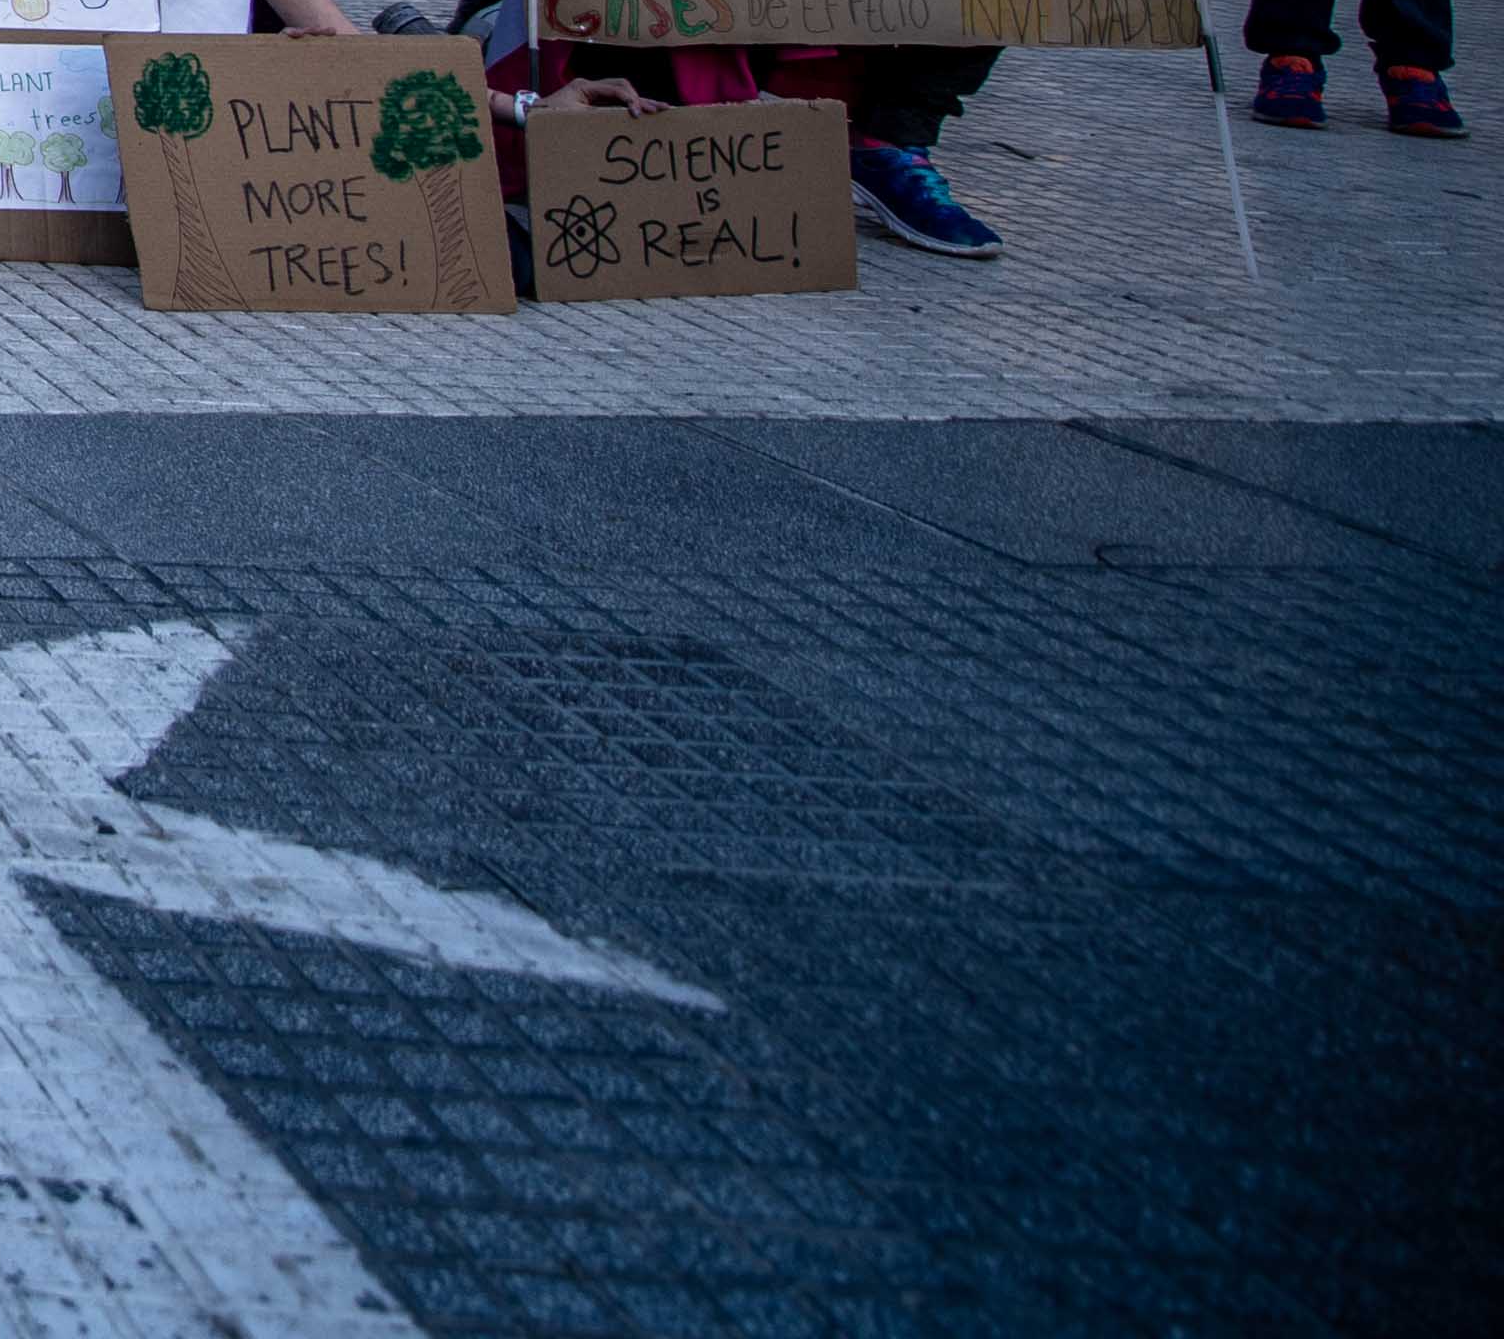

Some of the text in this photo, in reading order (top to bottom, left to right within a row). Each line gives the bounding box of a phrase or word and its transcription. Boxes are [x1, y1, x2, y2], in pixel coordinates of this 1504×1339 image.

[29, 108, 98, 130] trees
[230, 97, 374, 160] PLANT
[598, 130, 786, 186] SCIENCE
[242, 175, 368, 224] MORE
[640, 212, 801, 268] REAL!
[250, 240, 410, 298] TREES!
